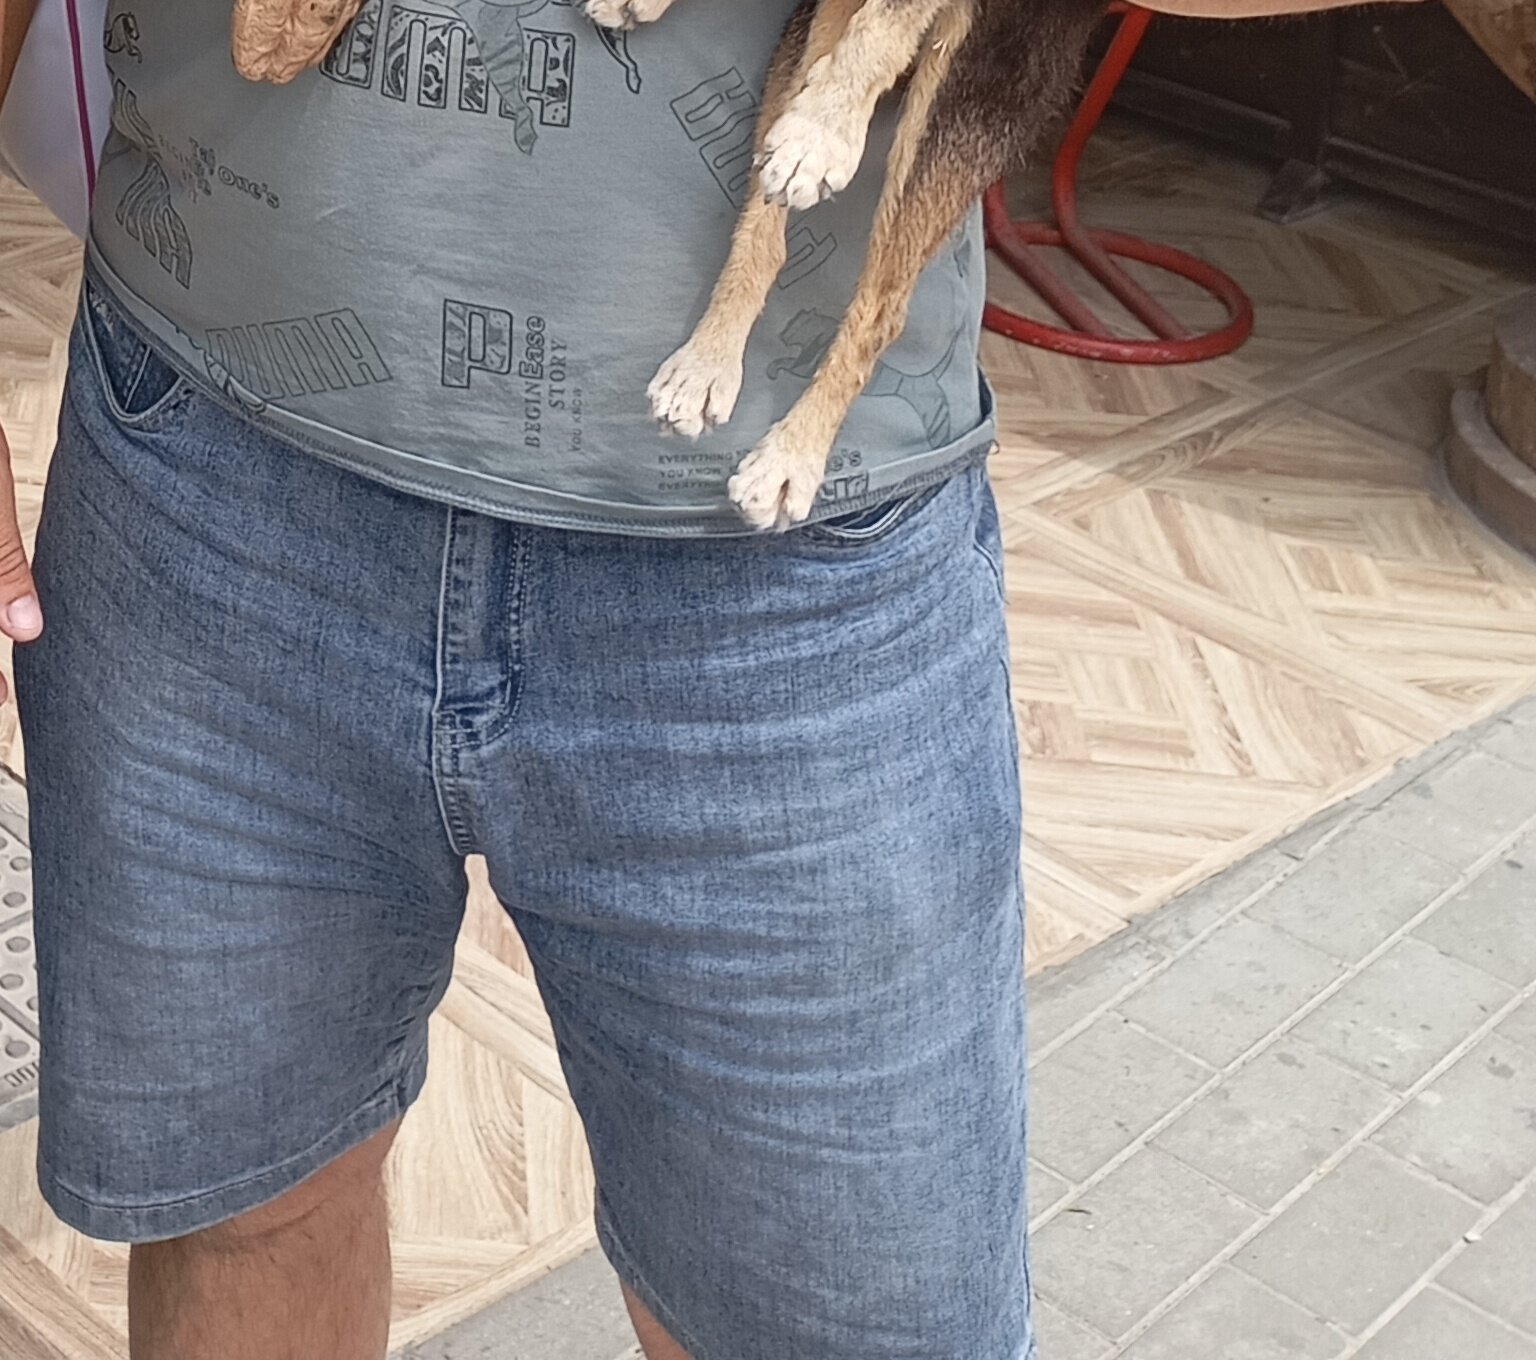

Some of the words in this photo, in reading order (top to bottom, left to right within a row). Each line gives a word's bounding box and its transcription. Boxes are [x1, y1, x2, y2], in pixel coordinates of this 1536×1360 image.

[519, 315, 546, 380] Ease
[548, 339, 567, 410] STORY
[524, 381, 542, 449] BEGIN
